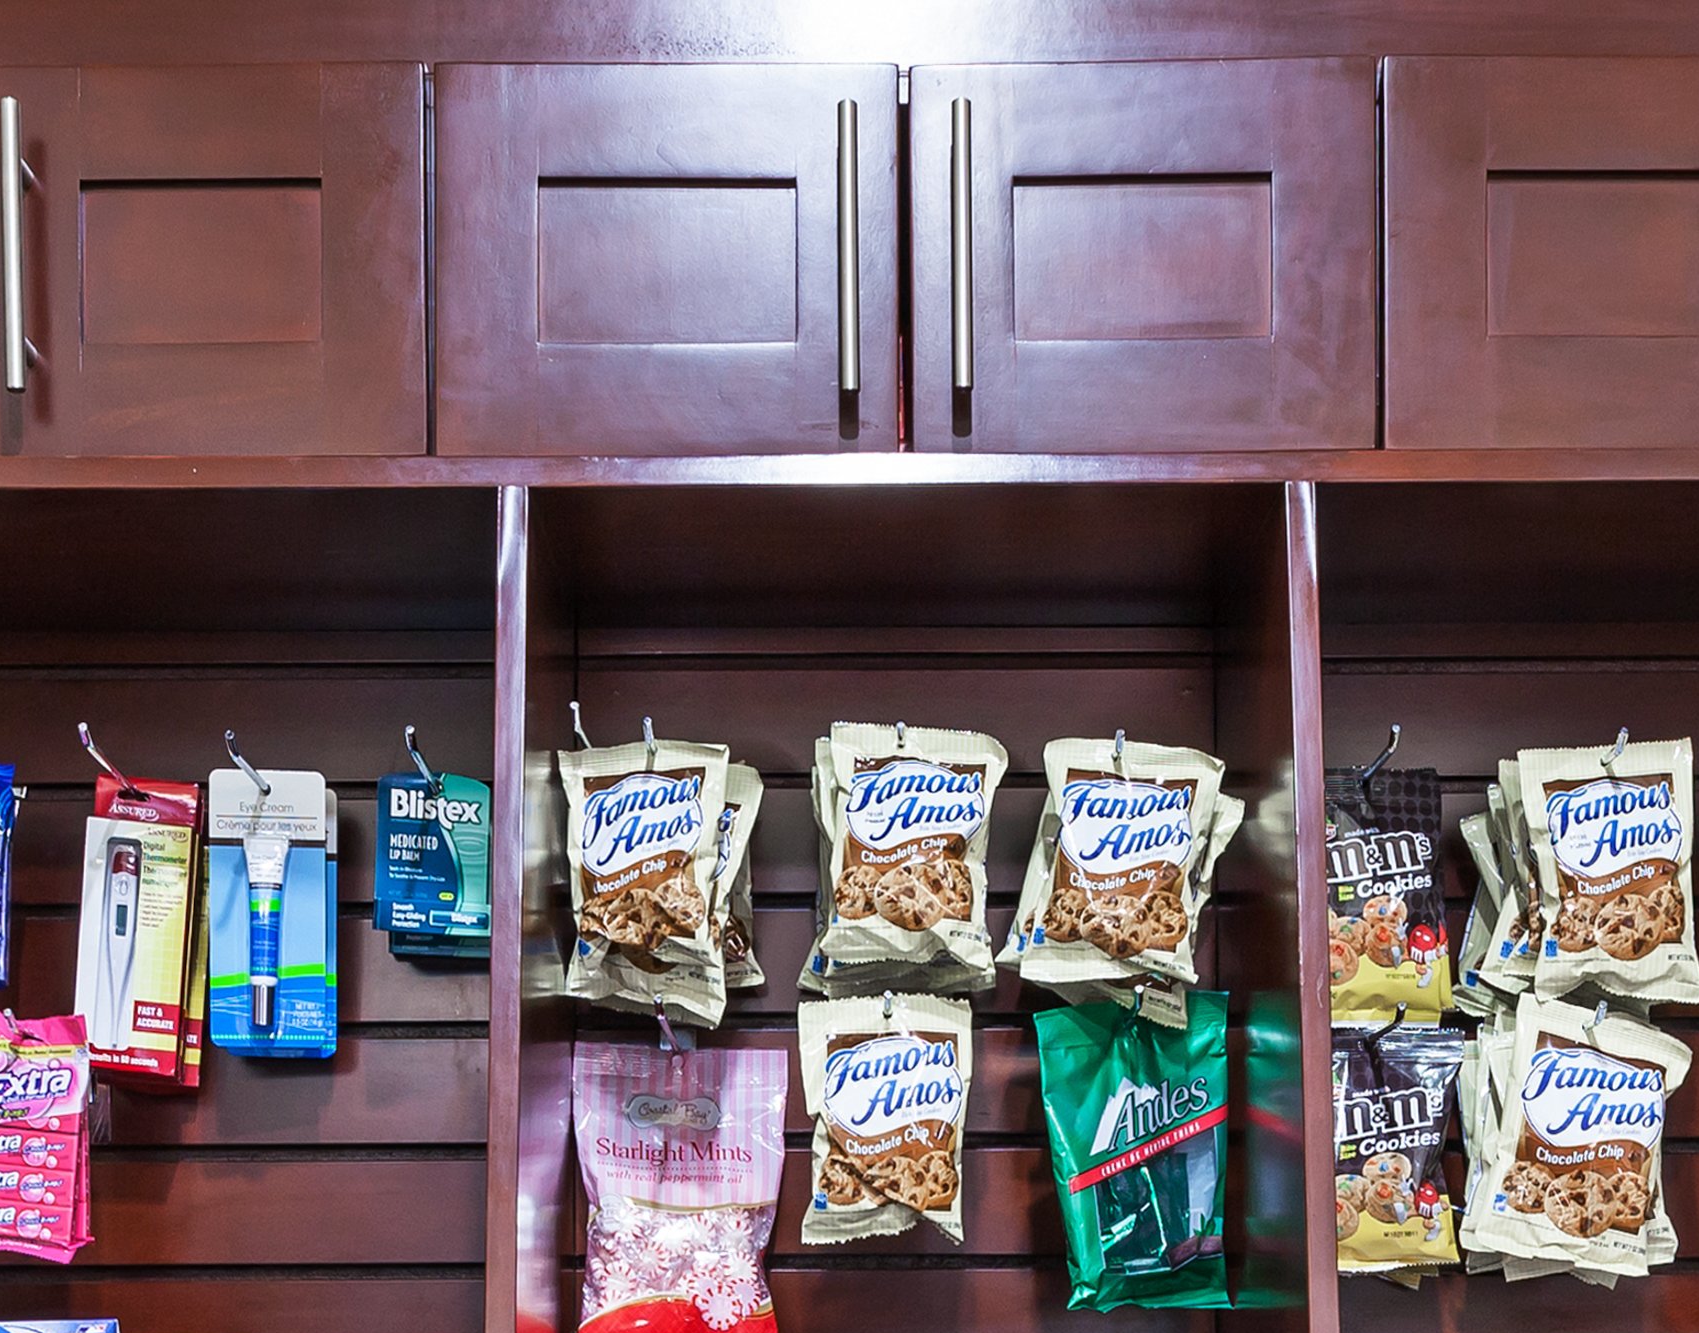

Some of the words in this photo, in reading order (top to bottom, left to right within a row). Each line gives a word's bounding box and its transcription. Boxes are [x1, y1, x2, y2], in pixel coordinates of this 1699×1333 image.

[846, 773, 981, 814] Famous
[109, 803, 159, 821] ASSURED
[239, 801, 257, 814] Eye
[260, 803, 294, 813] Cream
[390, 788, 481, 830] Blistex
[217, 818, 249, 831] Crème
[253, 822, 277, 834] pour
[294, 822, 316, 832] yeux
[870, 797, 985, 841] Amos
[390, 833, 438, 852] MEDICATED
[861, 840, 918, 865] Chocolate
[921, 836, 948, 854] Chip
[390, 849, 401, 860] LIP
[402, 849, 420, 861] BALM
[1357, 875, 1432, 897] Cookies
[137, 1005, 155, 1016] FAST
[156, 1007, 163, 1017] &
[136, 1017, 174, 1030] ACCURATE
[1108, 1078, 1208, 1152] Andes
[596, 1136, 686, 1165] Starlight
[691, 1140, 753, 1165] Mints
[1359, 1131, 1441, 1156] Cookies
[606, 1169, 633, 1183] with
[636, 1169, 657, 1184] real
[659, 1169, 724, 1188] peppermint
[728, 1172, 743, 1185] oil
